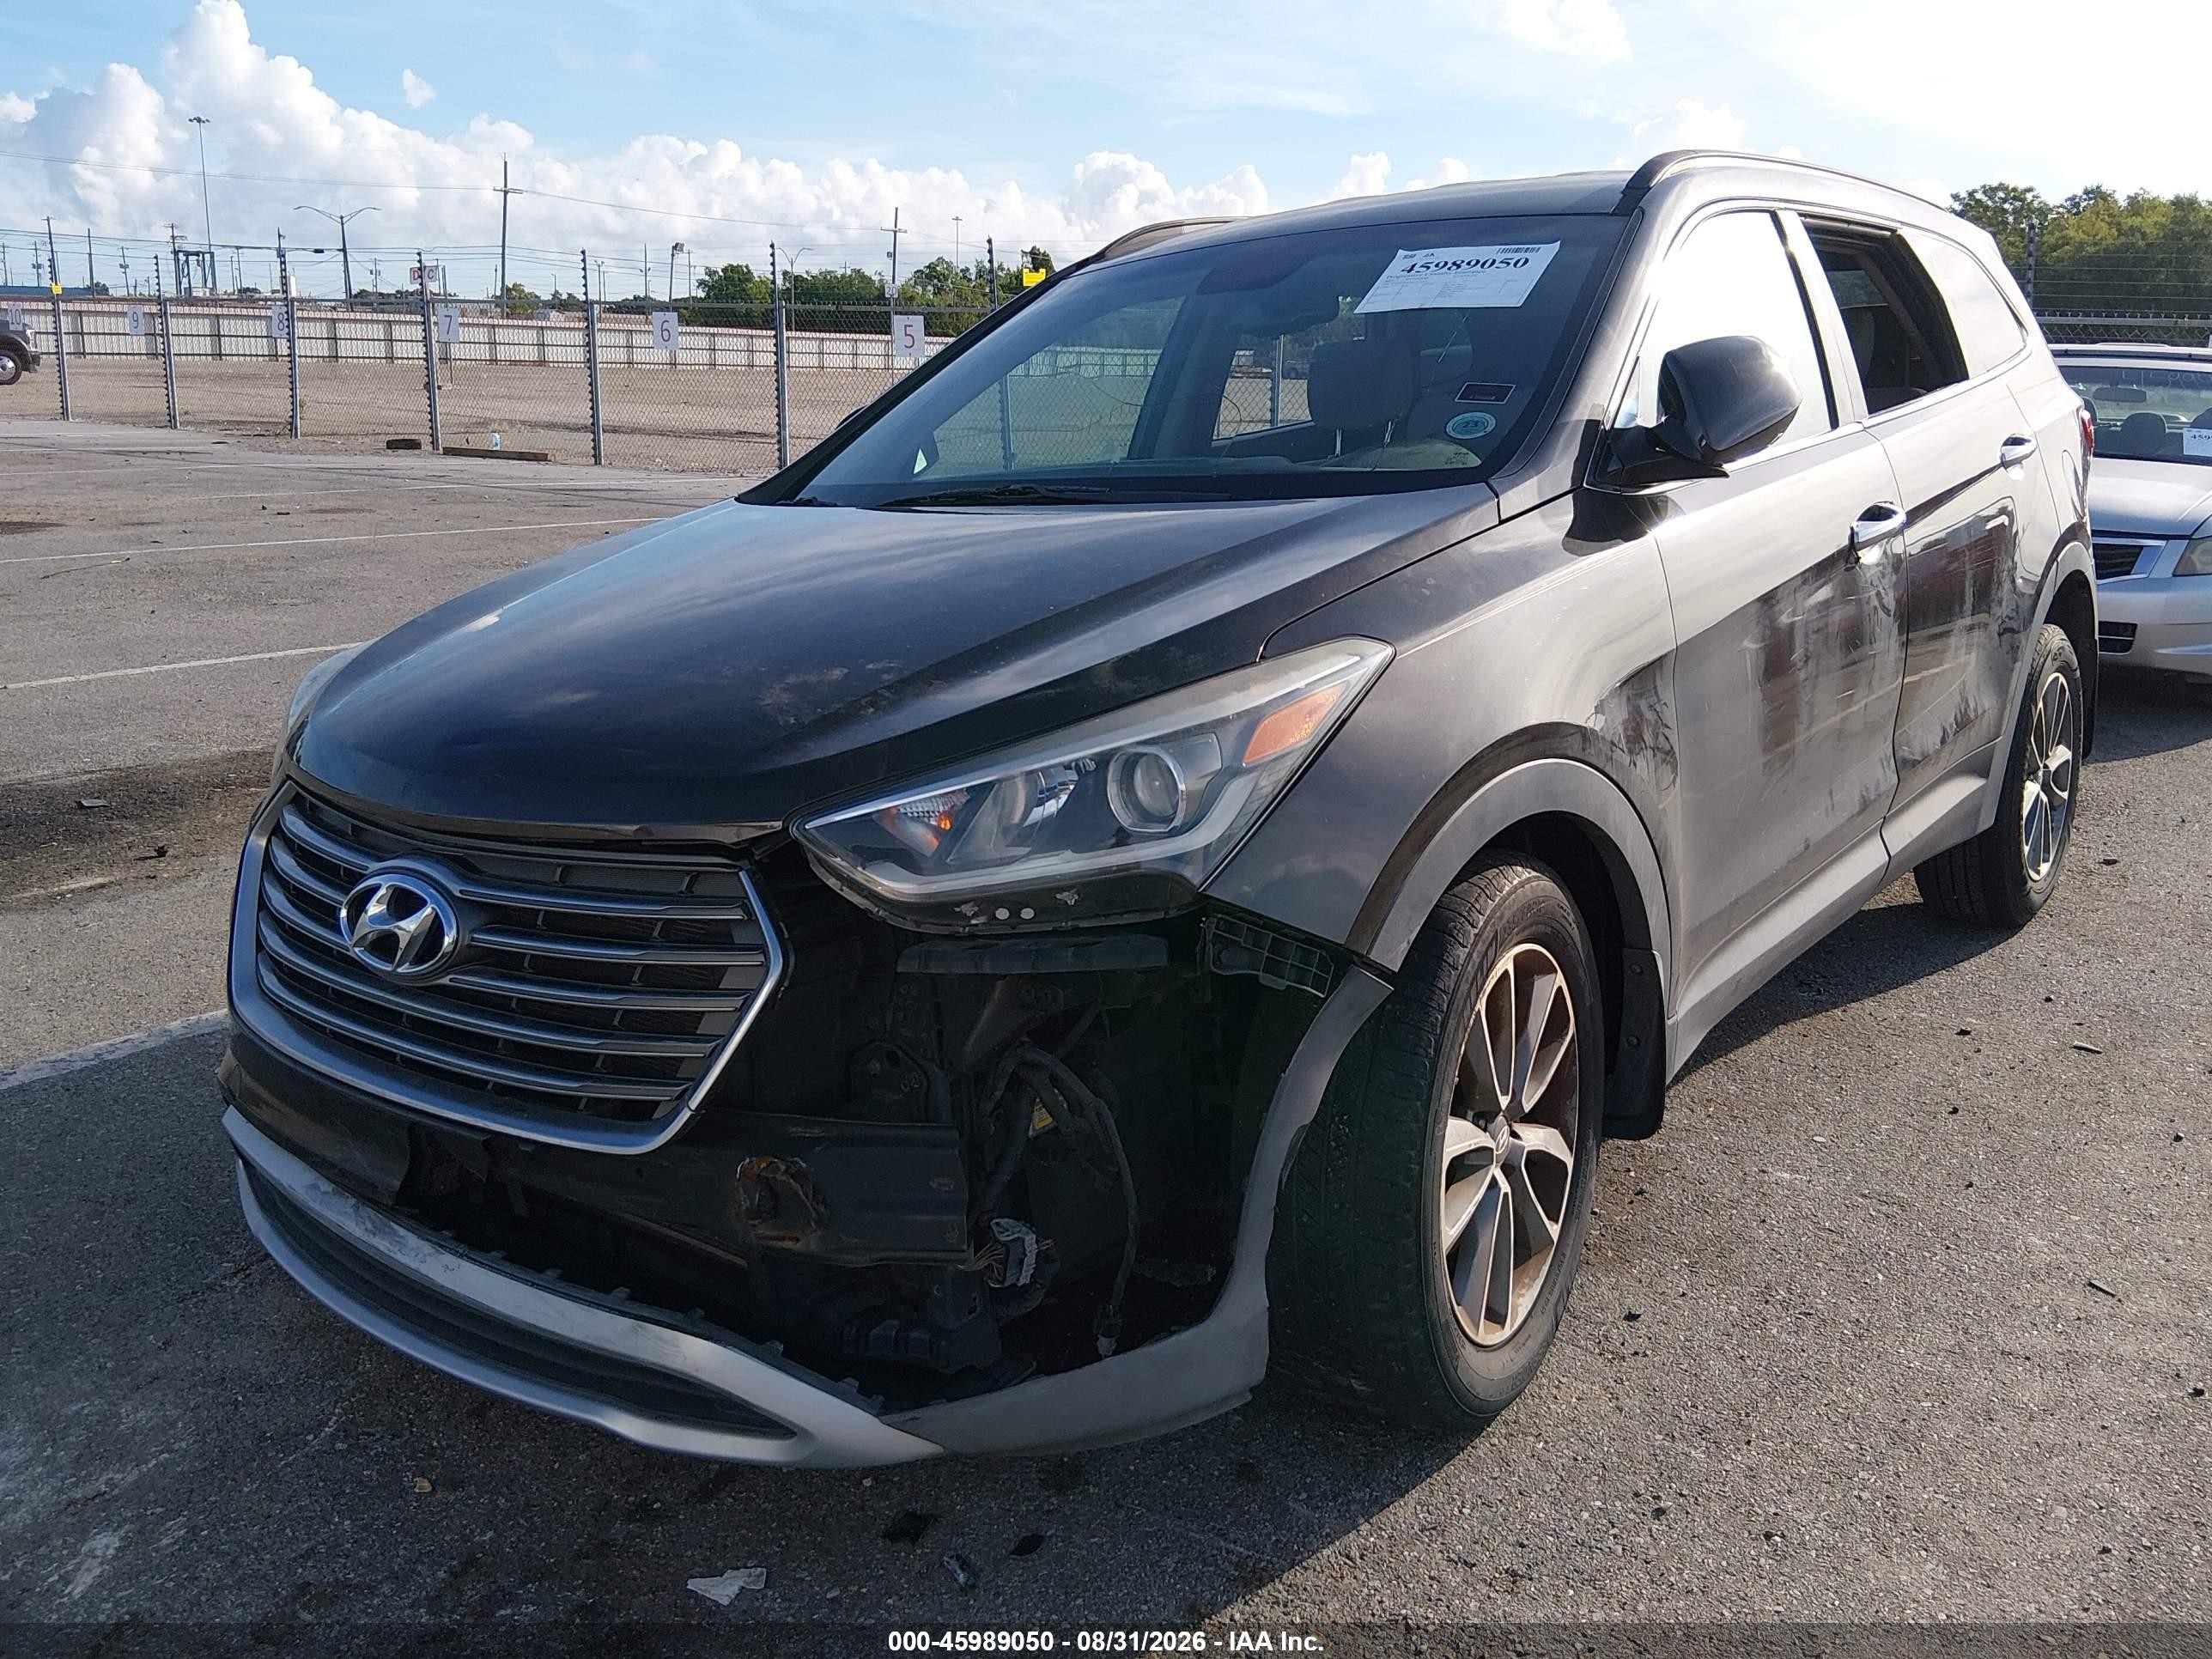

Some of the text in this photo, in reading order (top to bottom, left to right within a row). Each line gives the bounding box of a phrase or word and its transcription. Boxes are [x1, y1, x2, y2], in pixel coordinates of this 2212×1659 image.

[1401, 257, 1530, 274] 45989050
[412, 270, 420, 281] D
[428, 269, 434, 280] C
[886, 287, 896, 295] 20
[9, 308, 21, 325] 10
[132, 312, 139, 329] 9
[277, 313, 285, 331] 8
[444, 314, 453, 336] 7
[661, 319, 672, 343] 6
[903, 324, 915, 349] 5
